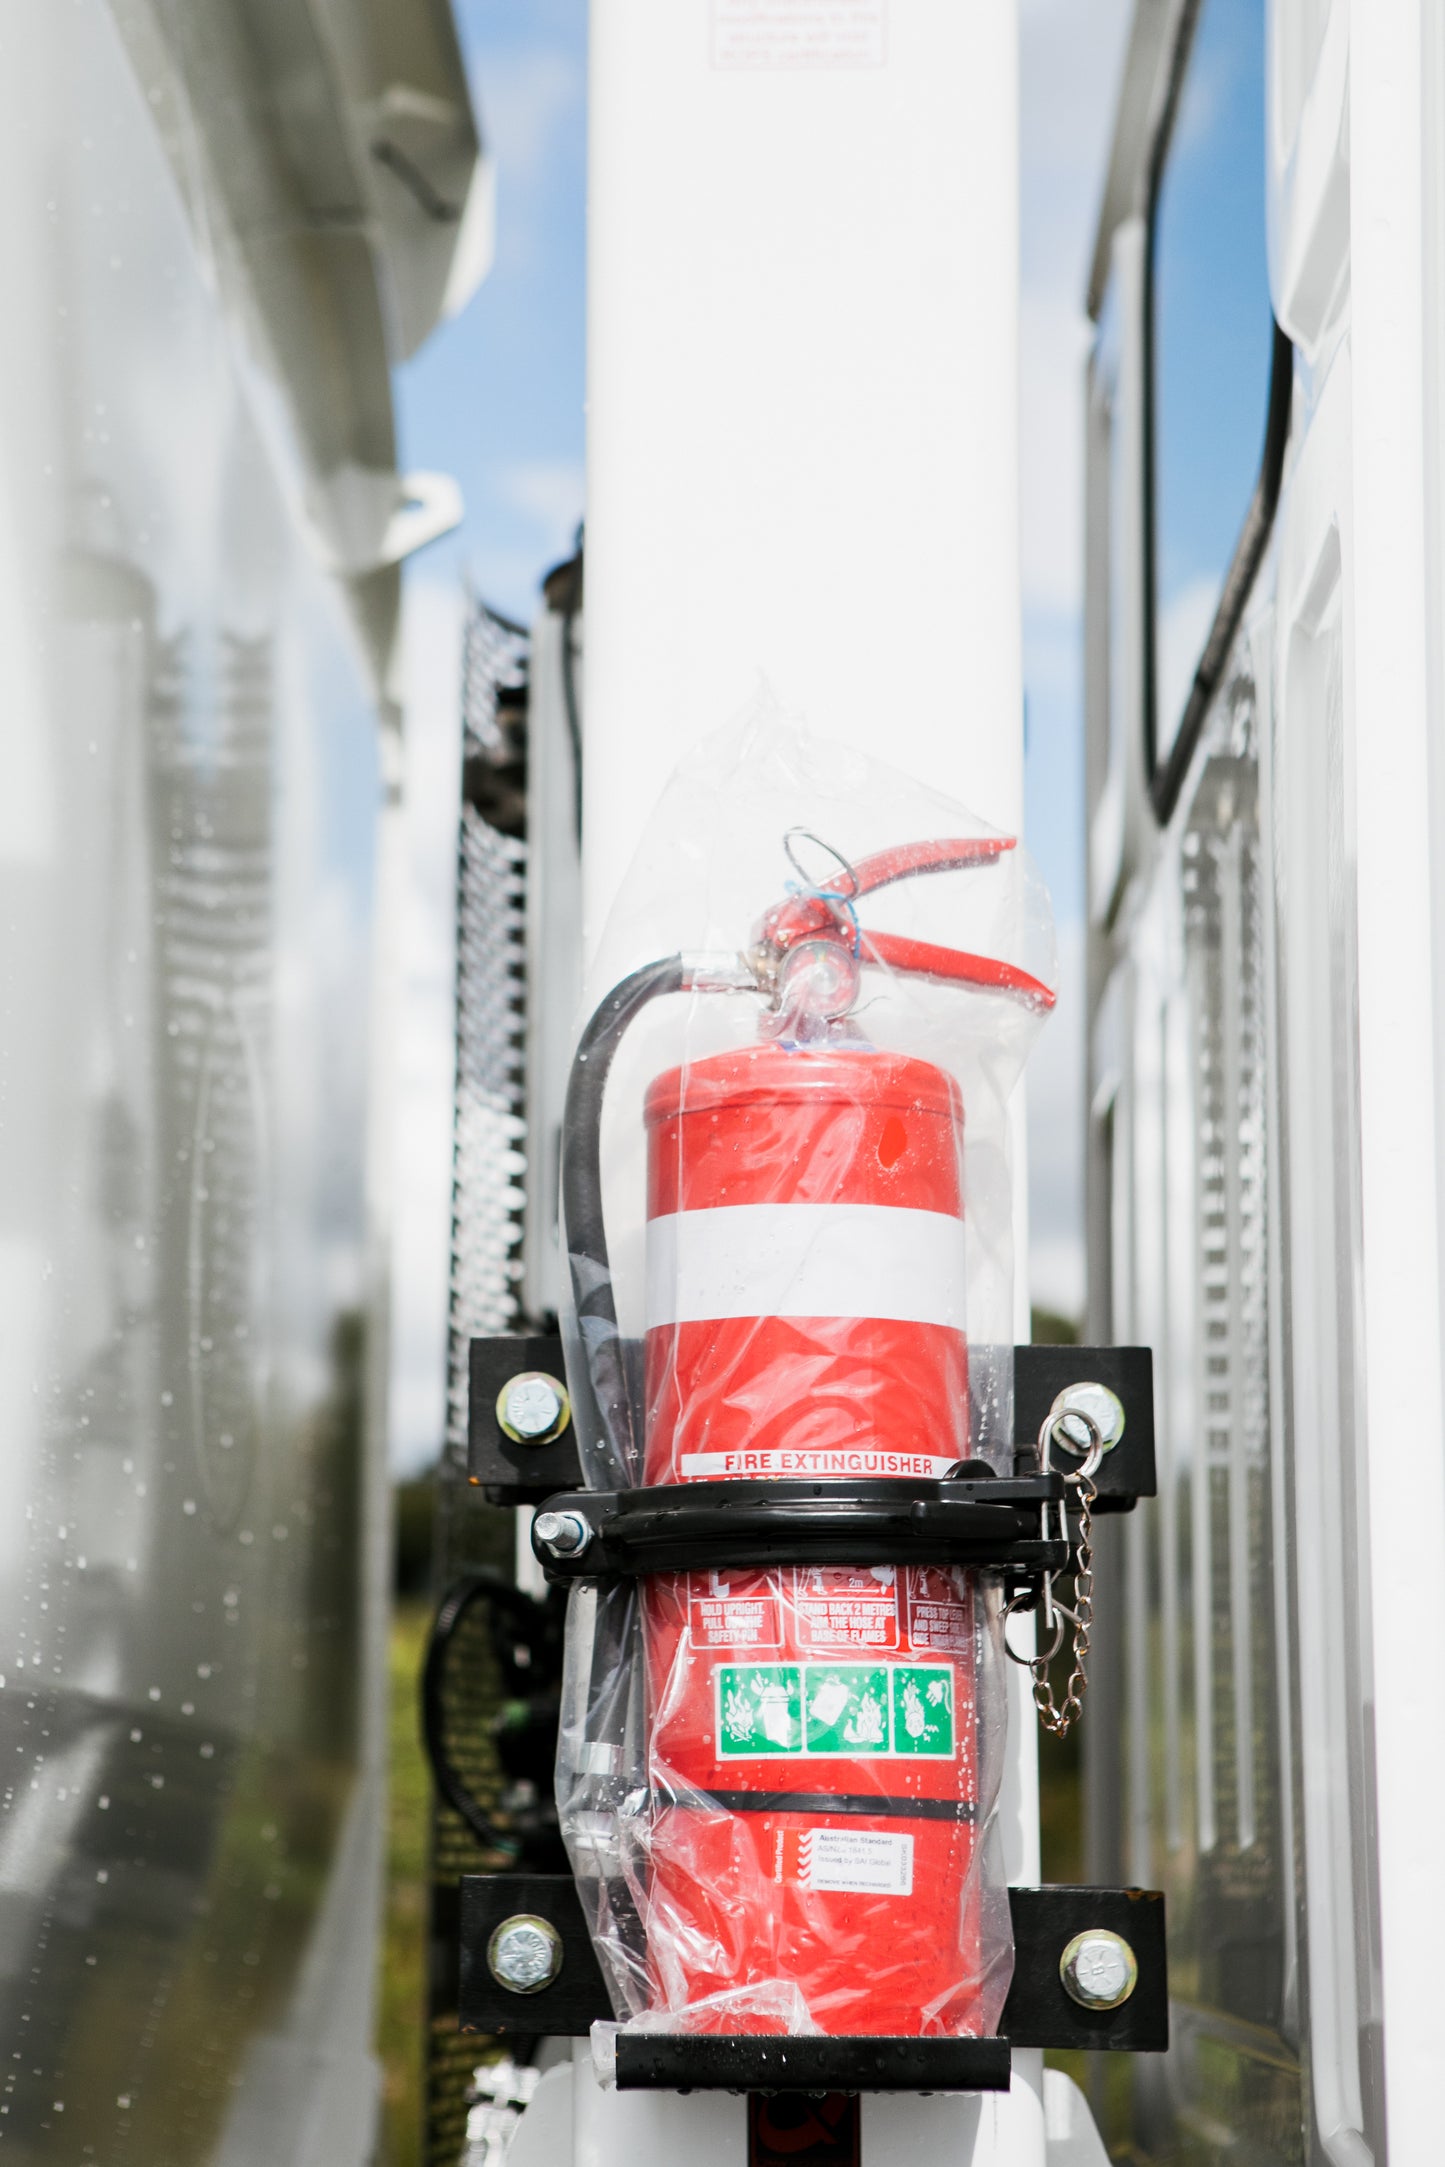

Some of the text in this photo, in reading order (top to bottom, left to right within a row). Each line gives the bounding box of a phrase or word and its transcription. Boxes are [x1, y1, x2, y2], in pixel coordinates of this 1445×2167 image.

[725, 1453, 933, 1475] FIRE EXTINGUISHER
[849, 1577, 864, 1588] 2m
[701, 1603, 723, 1616] HOLD
[798, 1602, 895, 1616] STAND BACK 2 METRES
[916, 1606, 938, 1619] PRESS
[703, 1616, 724, 1629] PULL
[829, 1616, 848, 1629] THE
[849, 1616, 874, 1629] HOSE
[875, 1616, 886, 1629] AT
[913, 1618, 928, 1632] AND
[929, 1620, 949, 1633] SWEEP
[708, 1629, 740, 1643] SAFETY
[811, 1629, 837, 1642] BASE
[850, 1630, 887, 1643] FLAMES
[819, 1834, 893, 1846] Australian Standard
[774, 1829, 784, 1884] Certified Product
